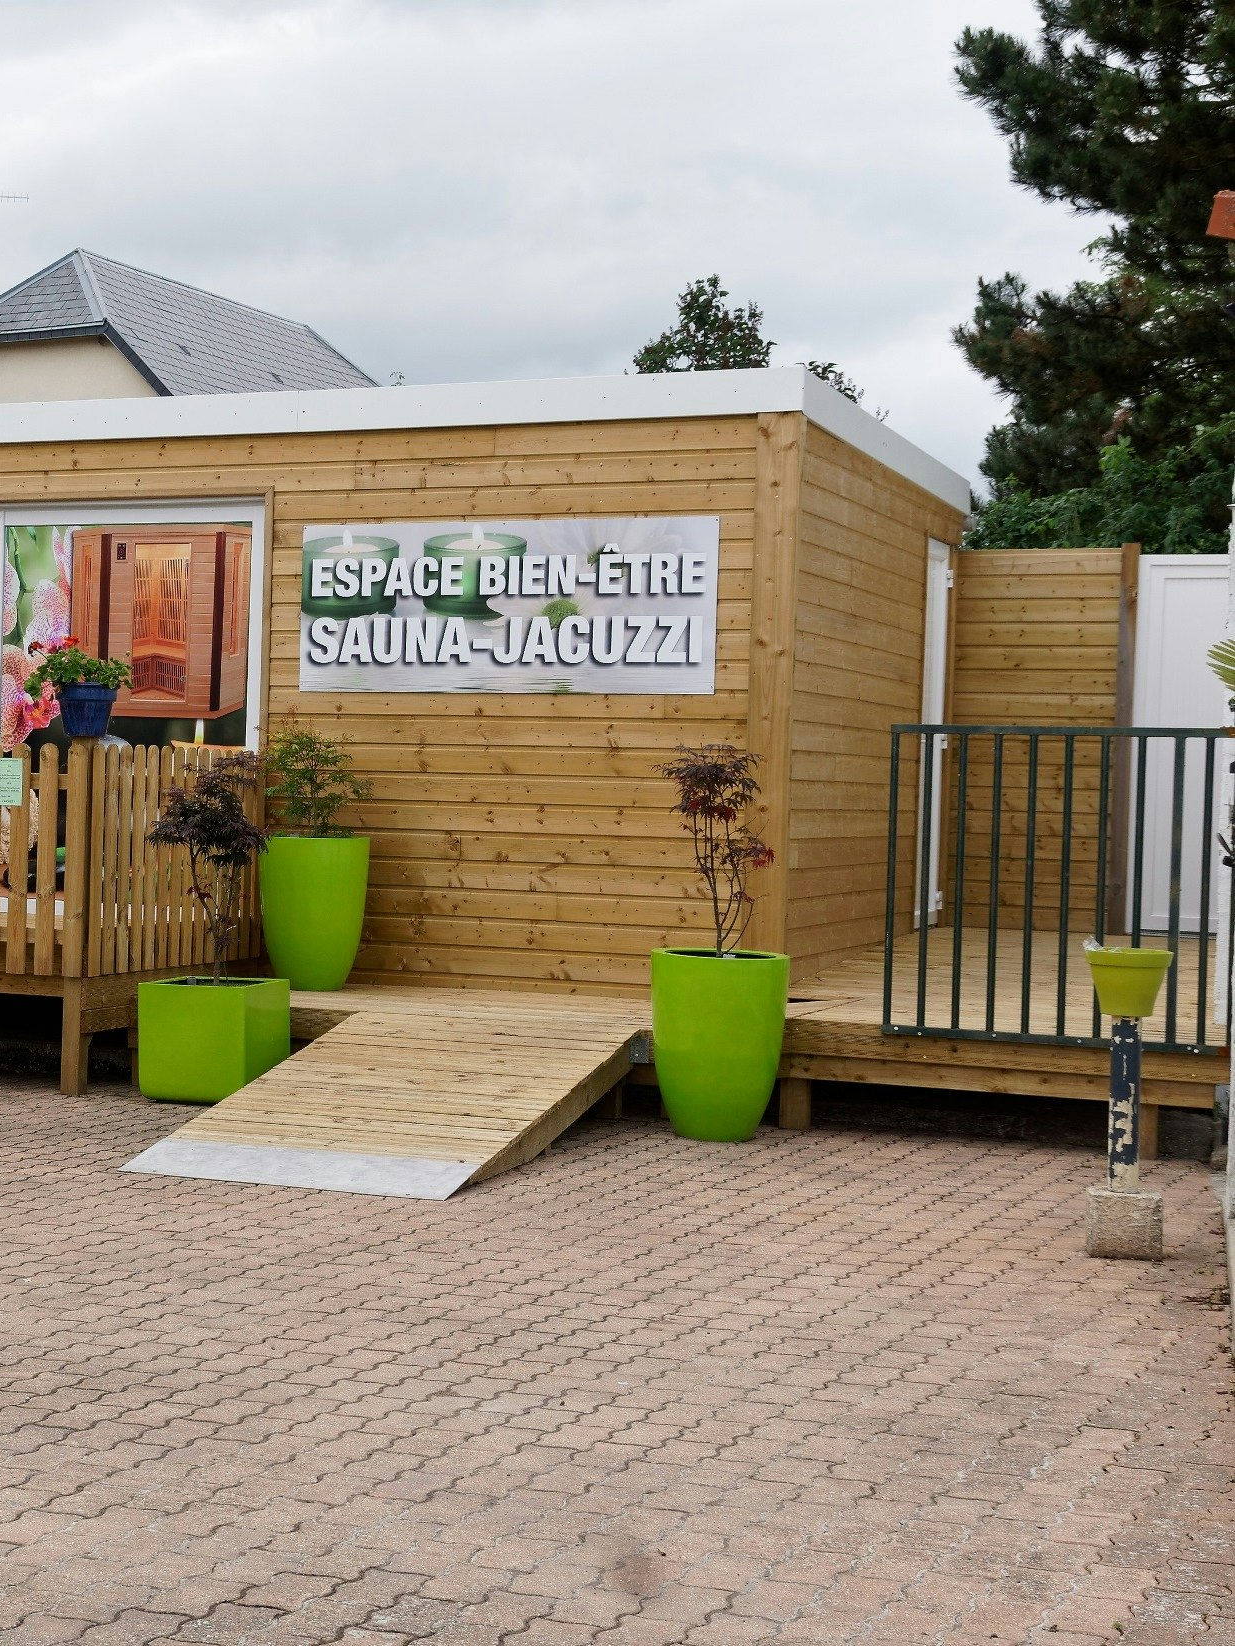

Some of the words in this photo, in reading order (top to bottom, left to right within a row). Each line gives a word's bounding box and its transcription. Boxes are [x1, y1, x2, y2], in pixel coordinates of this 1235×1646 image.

[311, 556, 464, 597] ESPACE
[479, 543, 707, 595] BIEN-ÊTRE
[309, 616, 703, 664] SAUNA-JACUZZI
